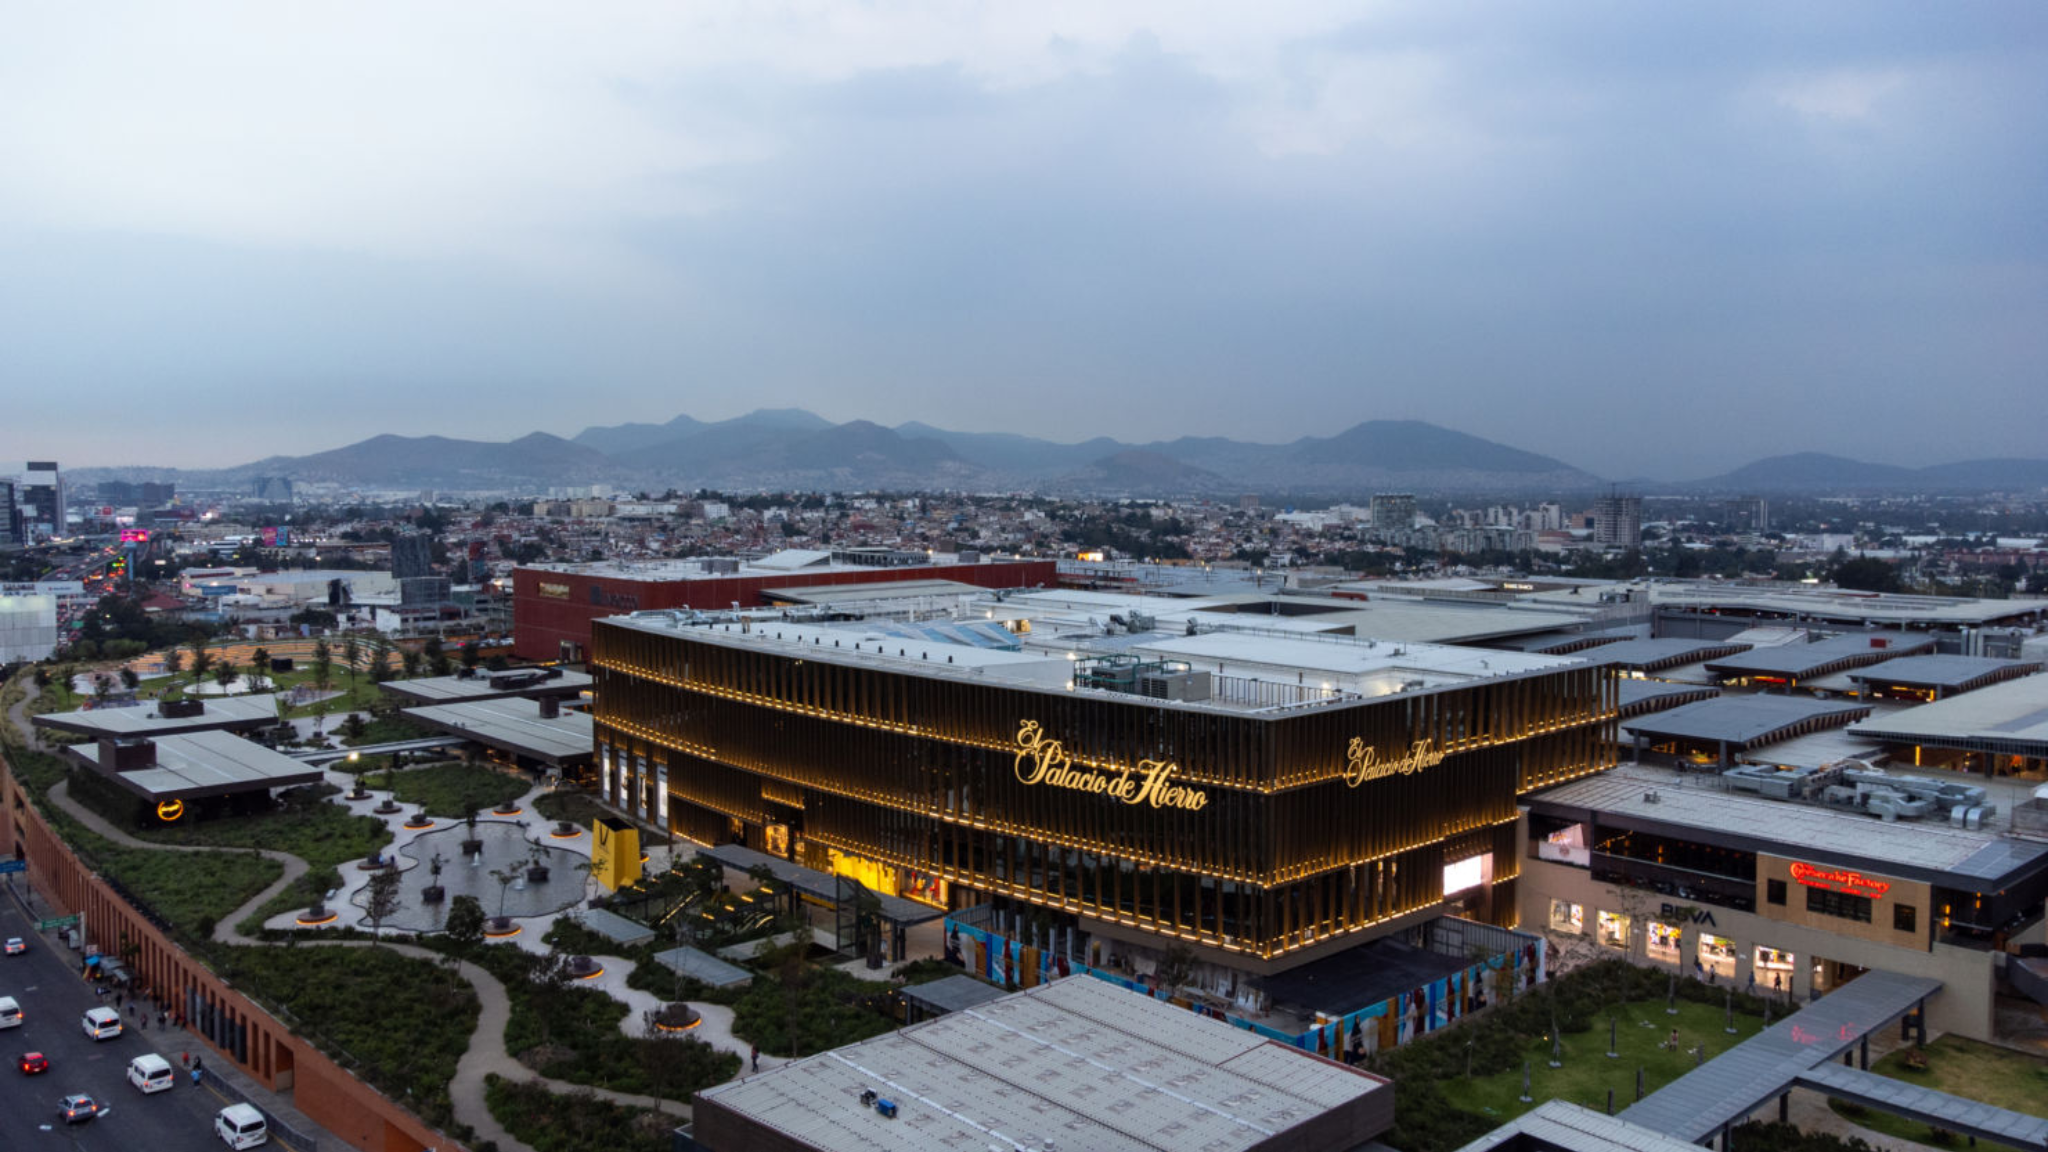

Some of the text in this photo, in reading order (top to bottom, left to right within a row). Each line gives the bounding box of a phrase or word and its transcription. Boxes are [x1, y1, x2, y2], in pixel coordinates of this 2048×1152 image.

[1016, 719, 1044, 748] El
[1346, 746, 1398, 788] Palacio
[1403, 738, 1444, 775] Hierro
[1347, 737, 1364, 760] El
[1014, 739, 1208, 811] Palacio de Hierro
[1661, 902, 1717, 928] BBVA
